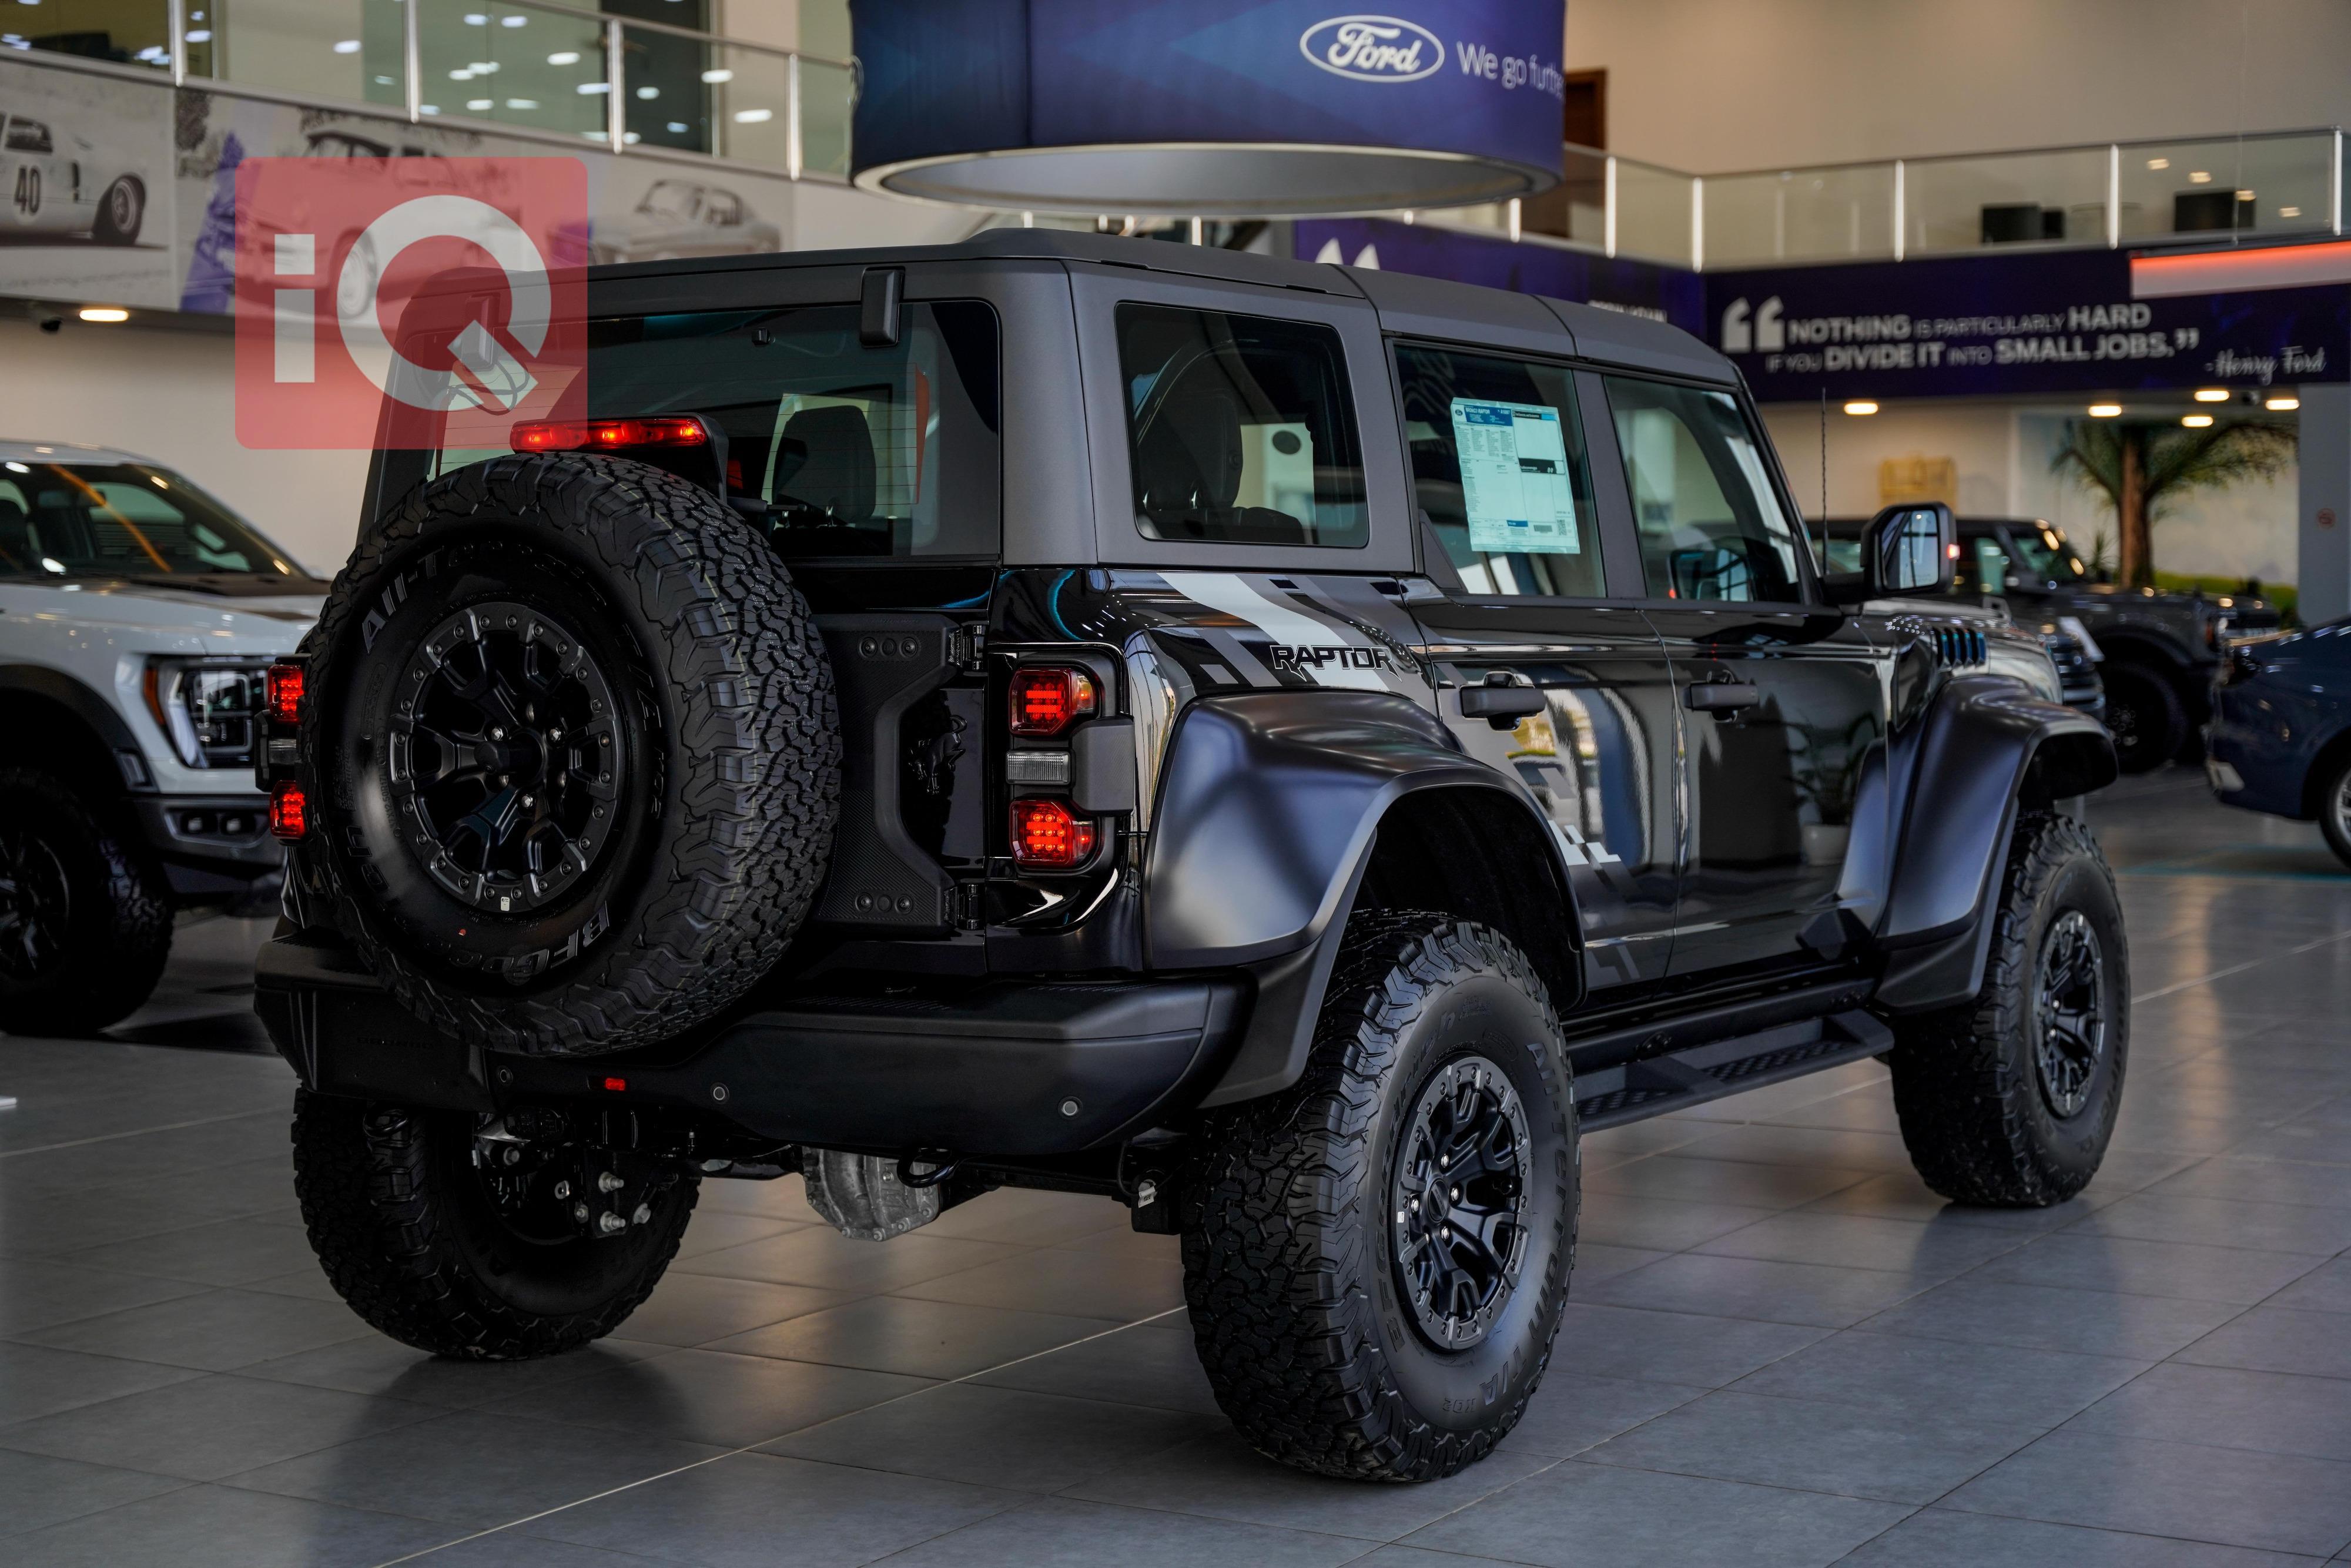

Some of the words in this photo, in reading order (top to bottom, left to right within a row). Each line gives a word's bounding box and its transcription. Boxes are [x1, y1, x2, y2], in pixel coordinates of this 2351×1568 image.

[1327, 22, 1423, 73] Ford
[1456, 41, 1498, 81] We
[1501, 56, 1527, 89] go
[14, 165, 41, 216] 40
[1787, 314, 1912, 344] NOTHING
[1913, 319, 1933, 340] IS
[1933, 313, 2066, 339] PARTICULARLY
[2067, 303, 2152, 332] HARD
[1764, 353, 1783, 374] IF
[1785, 353, 1823, 373] YOU
[1823, 341, 1915, 371] DIVIDE
[1917, 340, 1946, 369] IT
[1946, 346, 1992, 367] INTO
[1994, 334, 2091, 364] SMALL
[2280, 344, 2327, 375] Ford
[1269, 644, 1404, 682] RAPTOR
